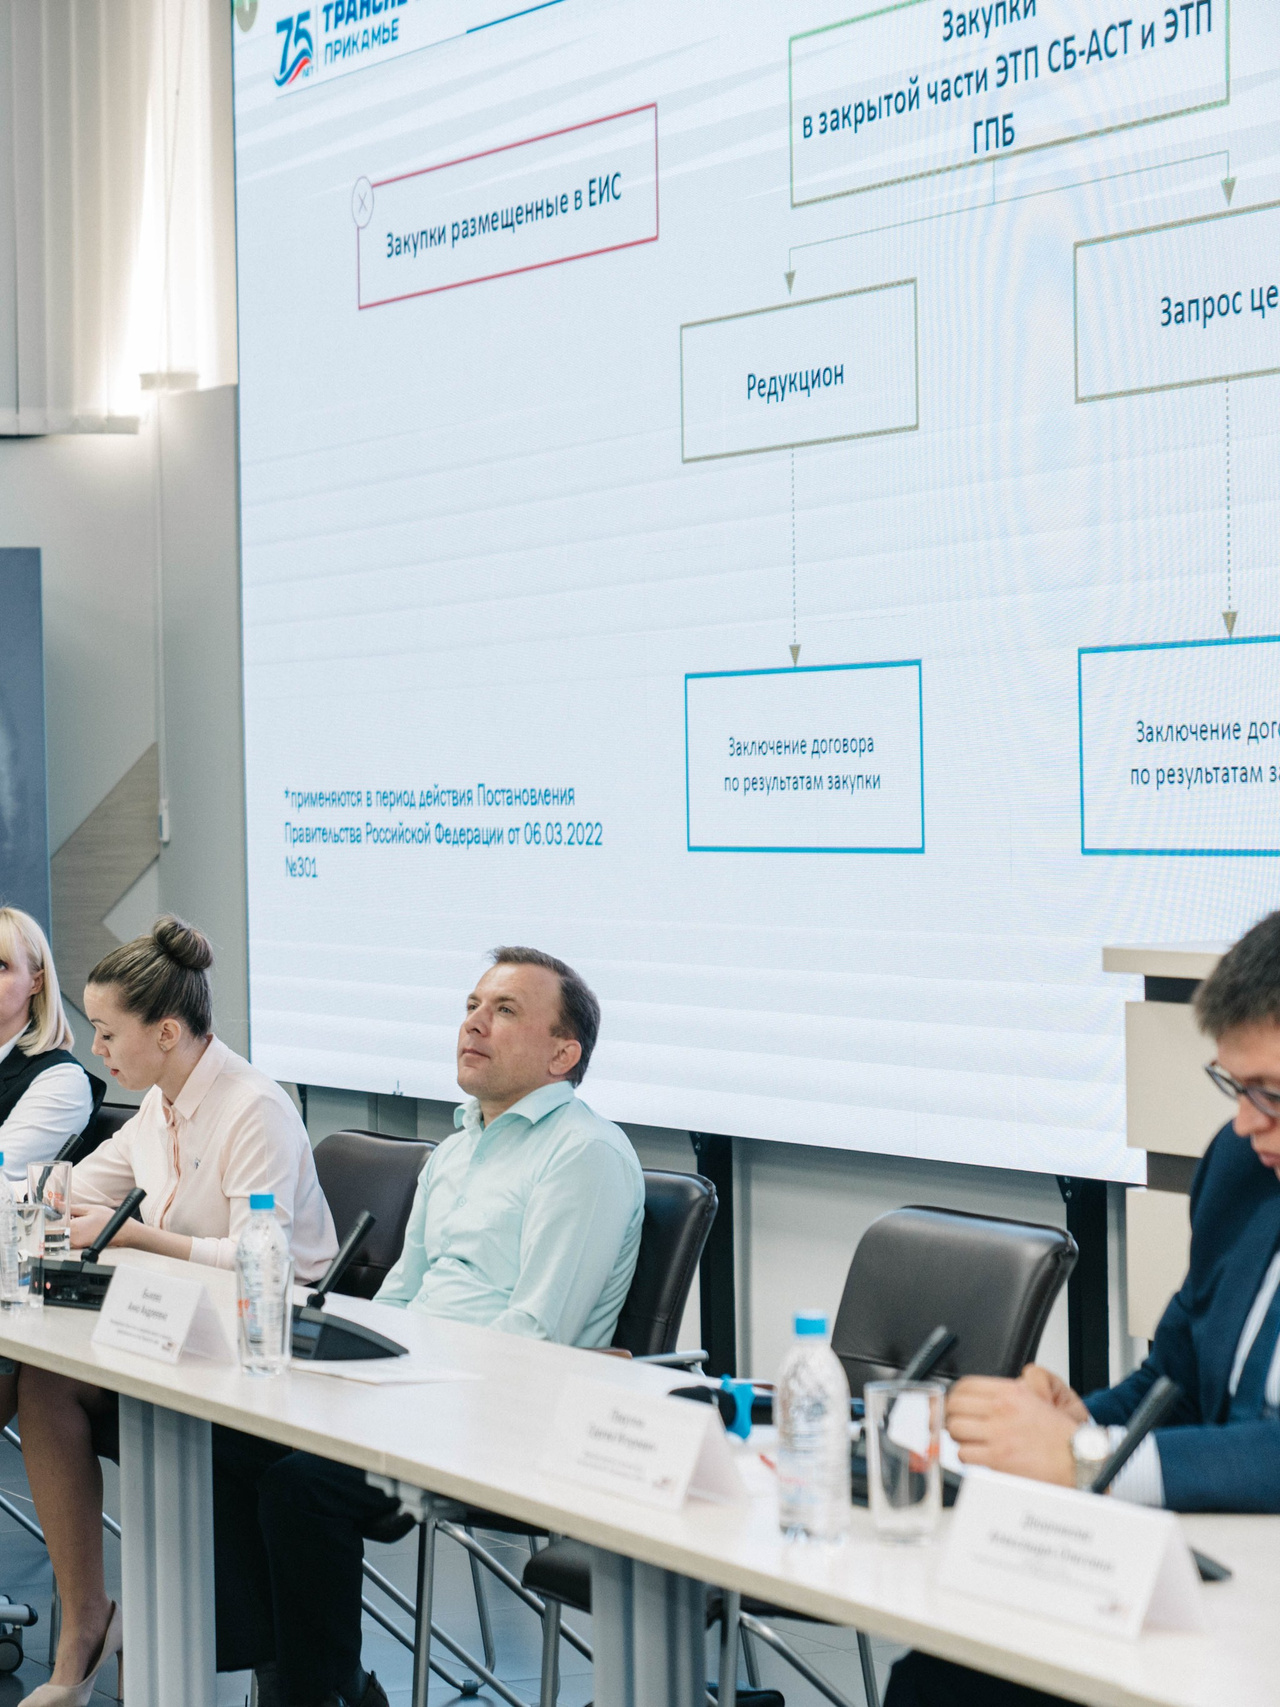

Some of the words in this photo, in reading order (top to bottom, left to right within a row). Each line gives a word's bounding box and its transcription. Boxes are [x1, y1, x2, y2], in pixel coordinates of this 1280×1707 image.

[942, 0, 1037, 42] Закупки
[275, 10, 314, 77] 75
[324, 18, 400, 65] ПРИКАМЬЕ
[802, 115, 813, 139] в
[819, 75, 920, 134] закрытой
[927, 67, 988, 105] части
[996, 45, 1039, 89] ЭТП
[1047, 19, 1133, 73] СБ-АСТ
[1141, 21, 1155, 50] и
[1164, 0, 1212, 44] ЭТП
[973, 111, 1016, 154] ГПБ
[386, 224, 447, 259] Закупки
[451, 193, 569, 248] размещенные
[574, 188, 583, 211] в
[588, 171, 623, 208] ЕИС
[1160, 290, 1242, 329] Запрос
[747, 363, 844, 404] Редукцион
[728, 735, 808, 757] Заключение
[811, 736, 875, 759] договора
[1136, 719, 1242, 743] Заключение
[1247, 720, 1280, 746] дог
[366, 790, 373, 808] в
[375, 790, 417, 812] период
[419, 784, 473, 810] действия
[477, 783, 575, 807] Постановления
[724, 776, 740, 791] по
[743, 774, 824, 796] результатам
[827, 773, 881, 795] закупки
[1130, 767, 1151, 785] по
[1156, 765, 1263, 791] результатам
[1269, 765, 1280, 783] з
[284, 822, 362, 848] Правительства
[365, 821, 432, 844] Российской
[434, 822, 504, 850] Федерации
[508, 826, 521, 845] от
[524, 821, 603, 846] 06.03.2022
[285, 855, 318, 878] №301
